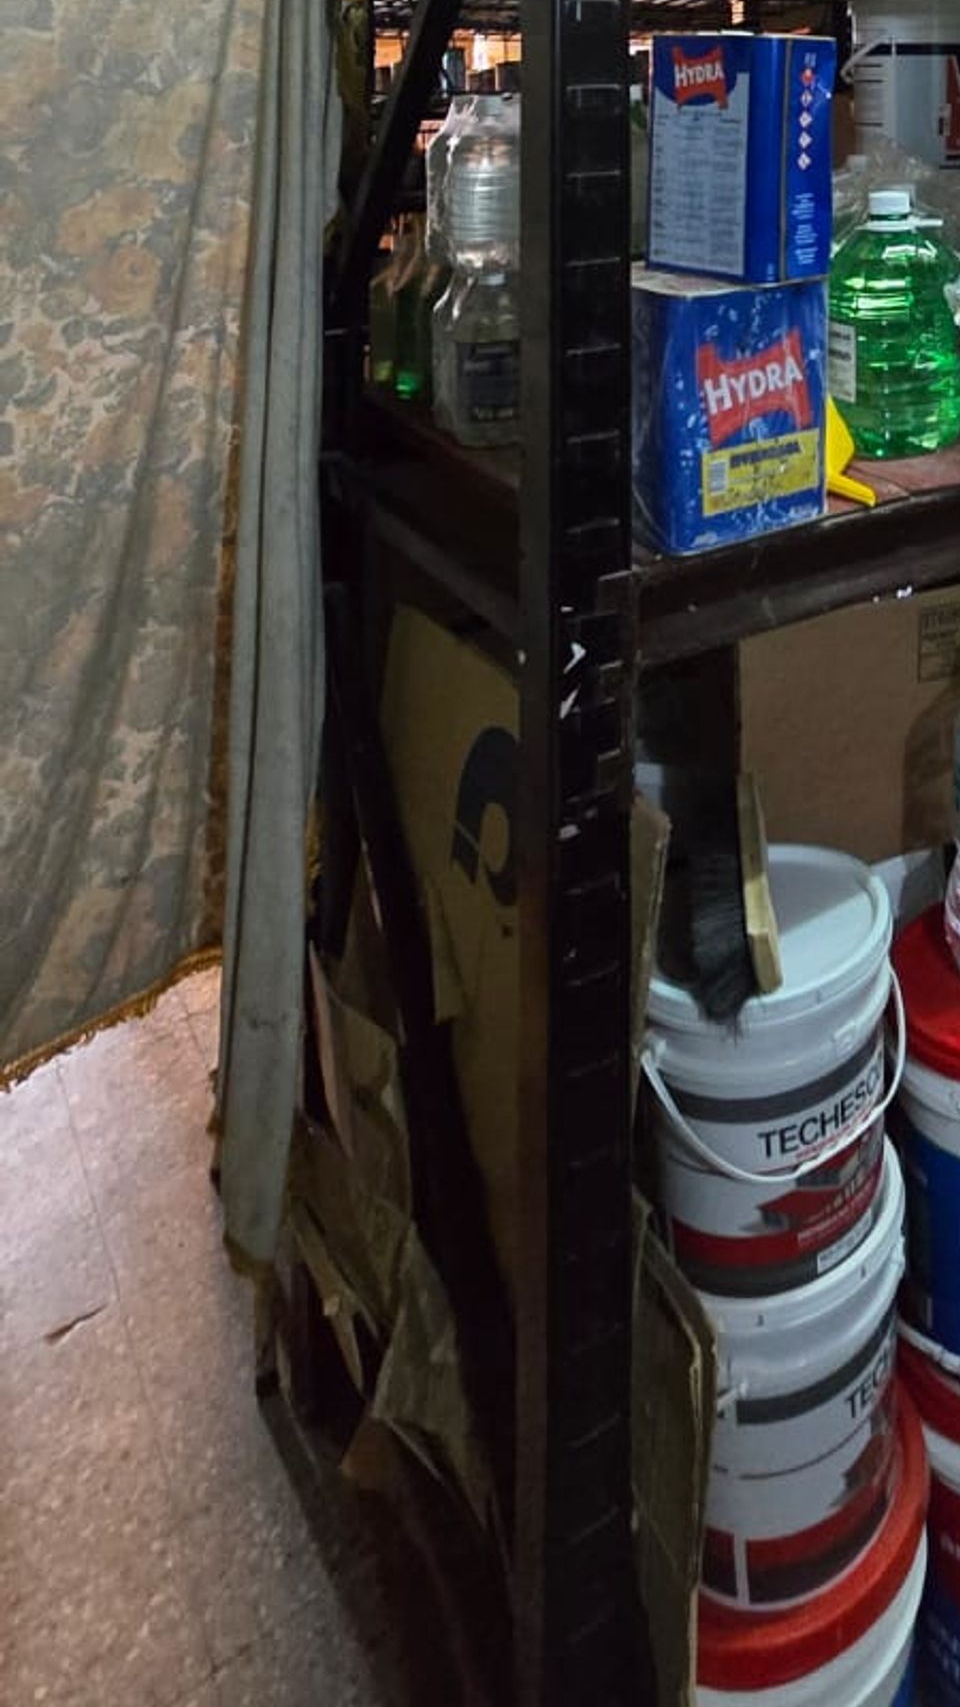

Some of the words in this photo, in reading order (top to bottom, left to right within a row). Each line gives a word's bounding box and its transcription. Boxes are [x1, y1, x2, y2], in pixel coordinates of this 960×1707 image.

[674, 60, 725, 89] HYDRA
[704, 356, 803, 416] HYDRA
[758, 1056, 881, 1158] TECHESO
